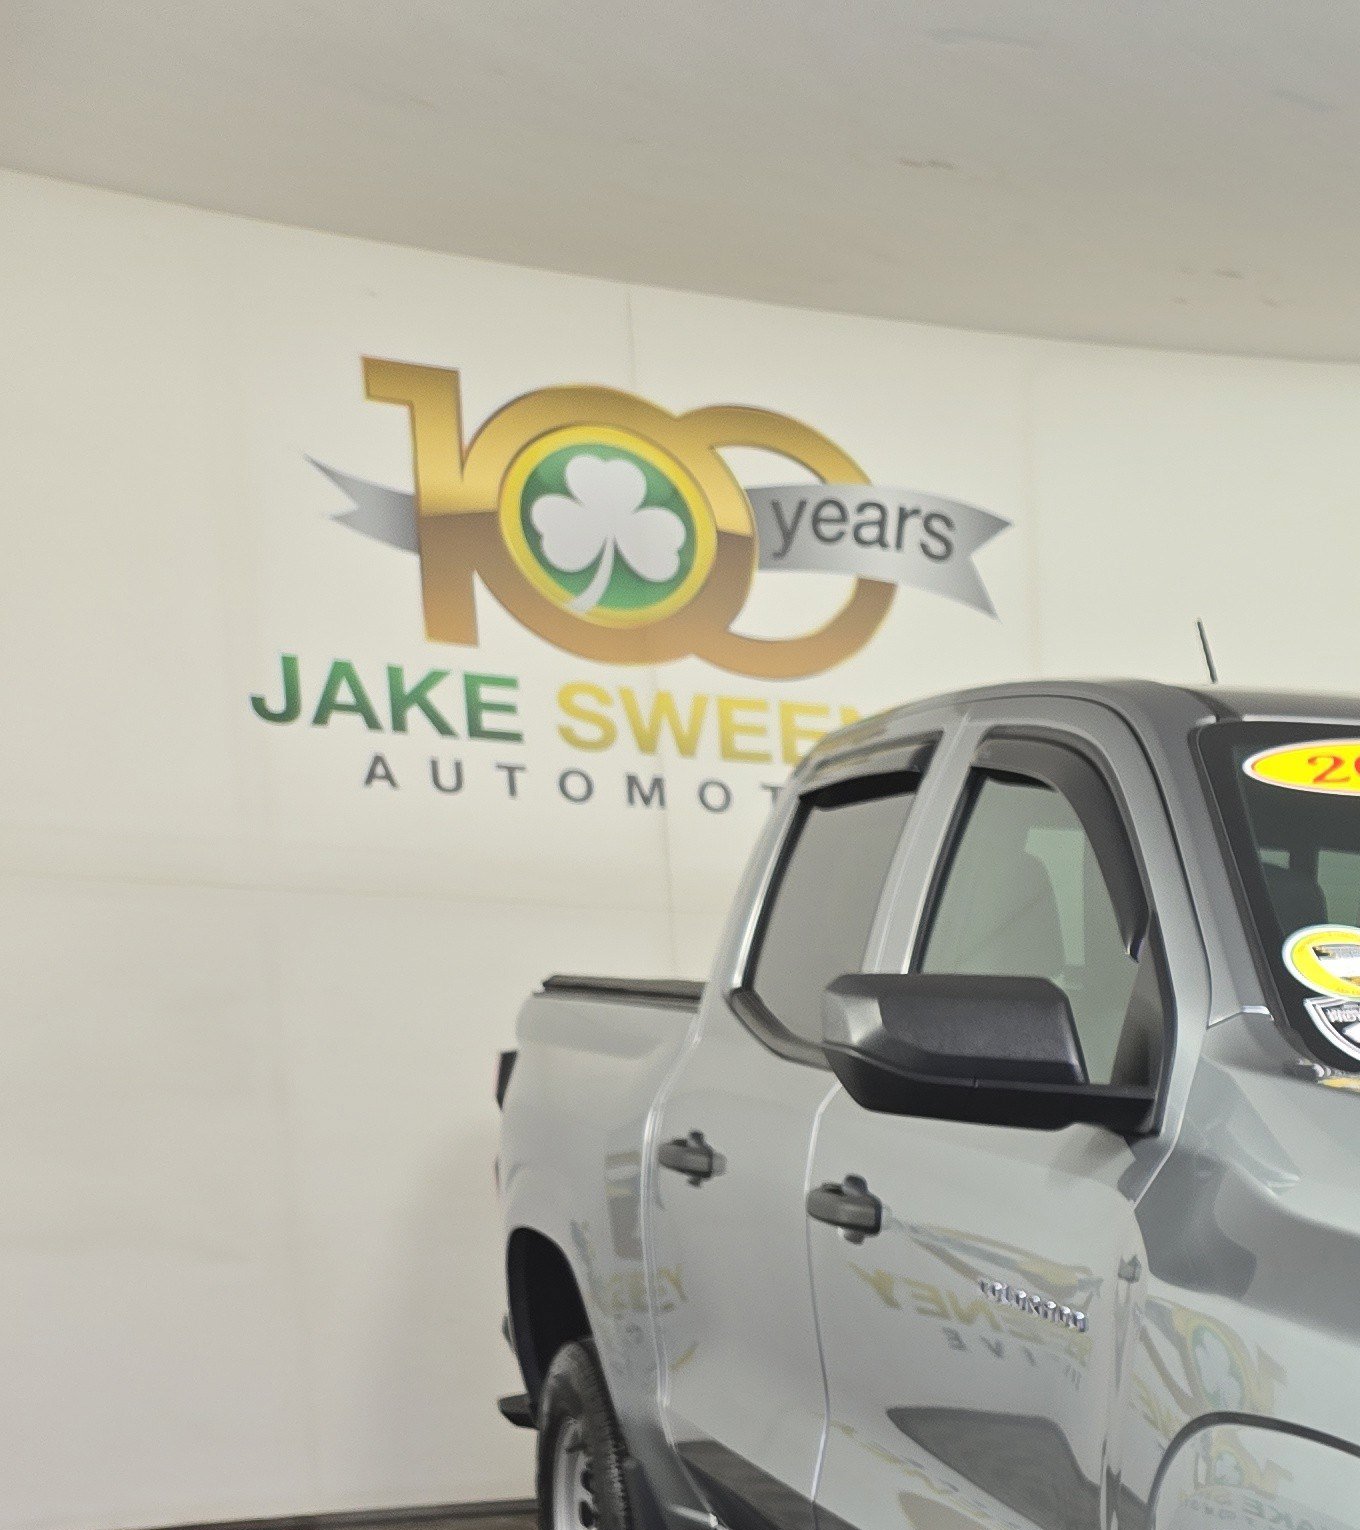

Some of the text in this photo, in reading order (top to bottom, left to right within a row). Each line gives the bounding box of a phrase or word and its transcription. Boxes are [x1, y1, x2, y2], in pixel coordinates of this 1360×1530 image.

[769, 491, 956, 562] years
[250, 653, 862, 766] JAKE SWEE
